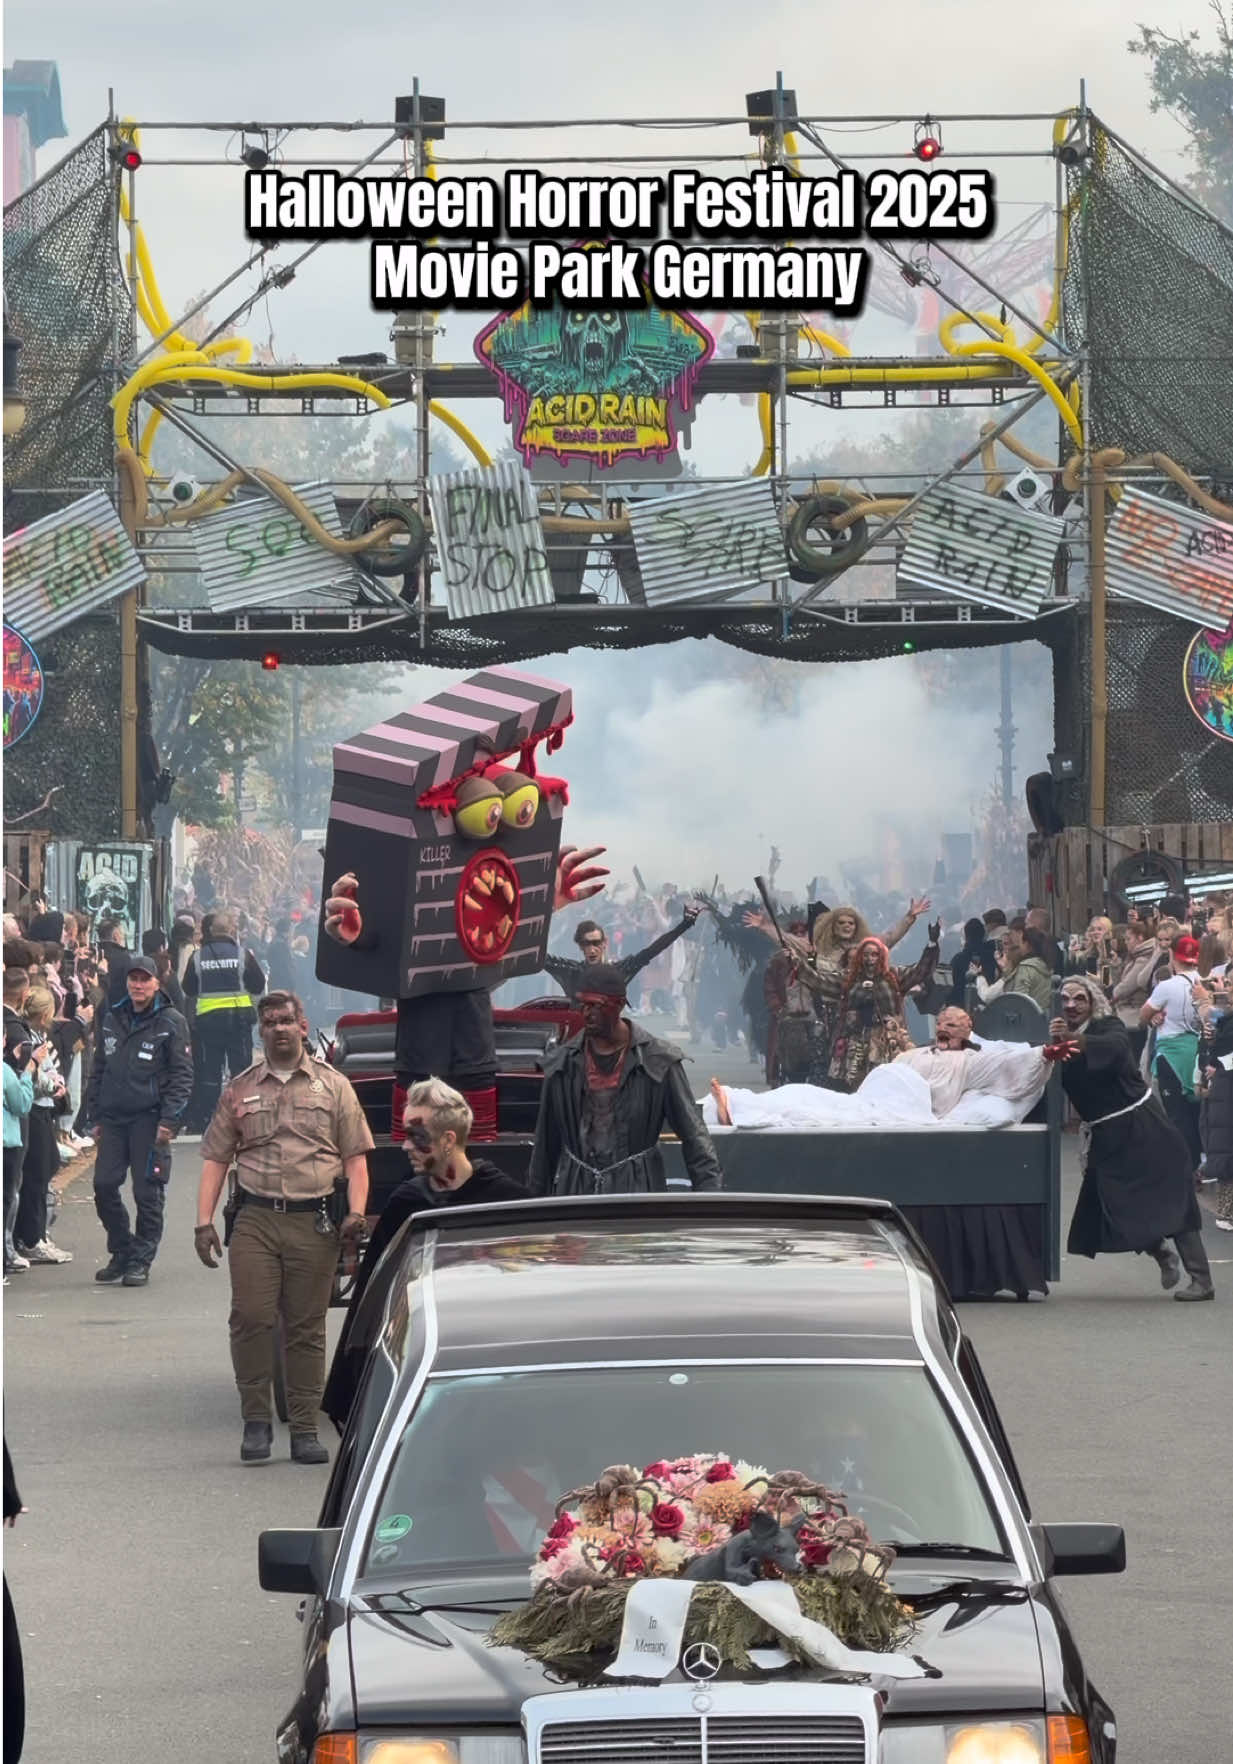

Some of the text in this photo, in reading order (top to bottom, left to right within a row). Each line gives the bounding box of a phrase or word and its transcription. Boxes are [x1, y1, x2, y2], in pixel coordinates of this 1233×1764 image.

[526, 393, 668, 431] ACID RAIN
[602, 427, 637, 442] ZONE
[446, 480, 540, 537] FINAL
[931, 498, 1032, 554] ACID
[446, 542, 548, 598] STOP
[935, 545, 1038, 599] RAIN
[79, 852, 138, 883] ACID
[420, 845, 451, 864] KILLER
[200, 959, 239, 969] SECURITY
[648, 1615, 657, 1630] In
[633, 1638, 669, 1657] Memory
